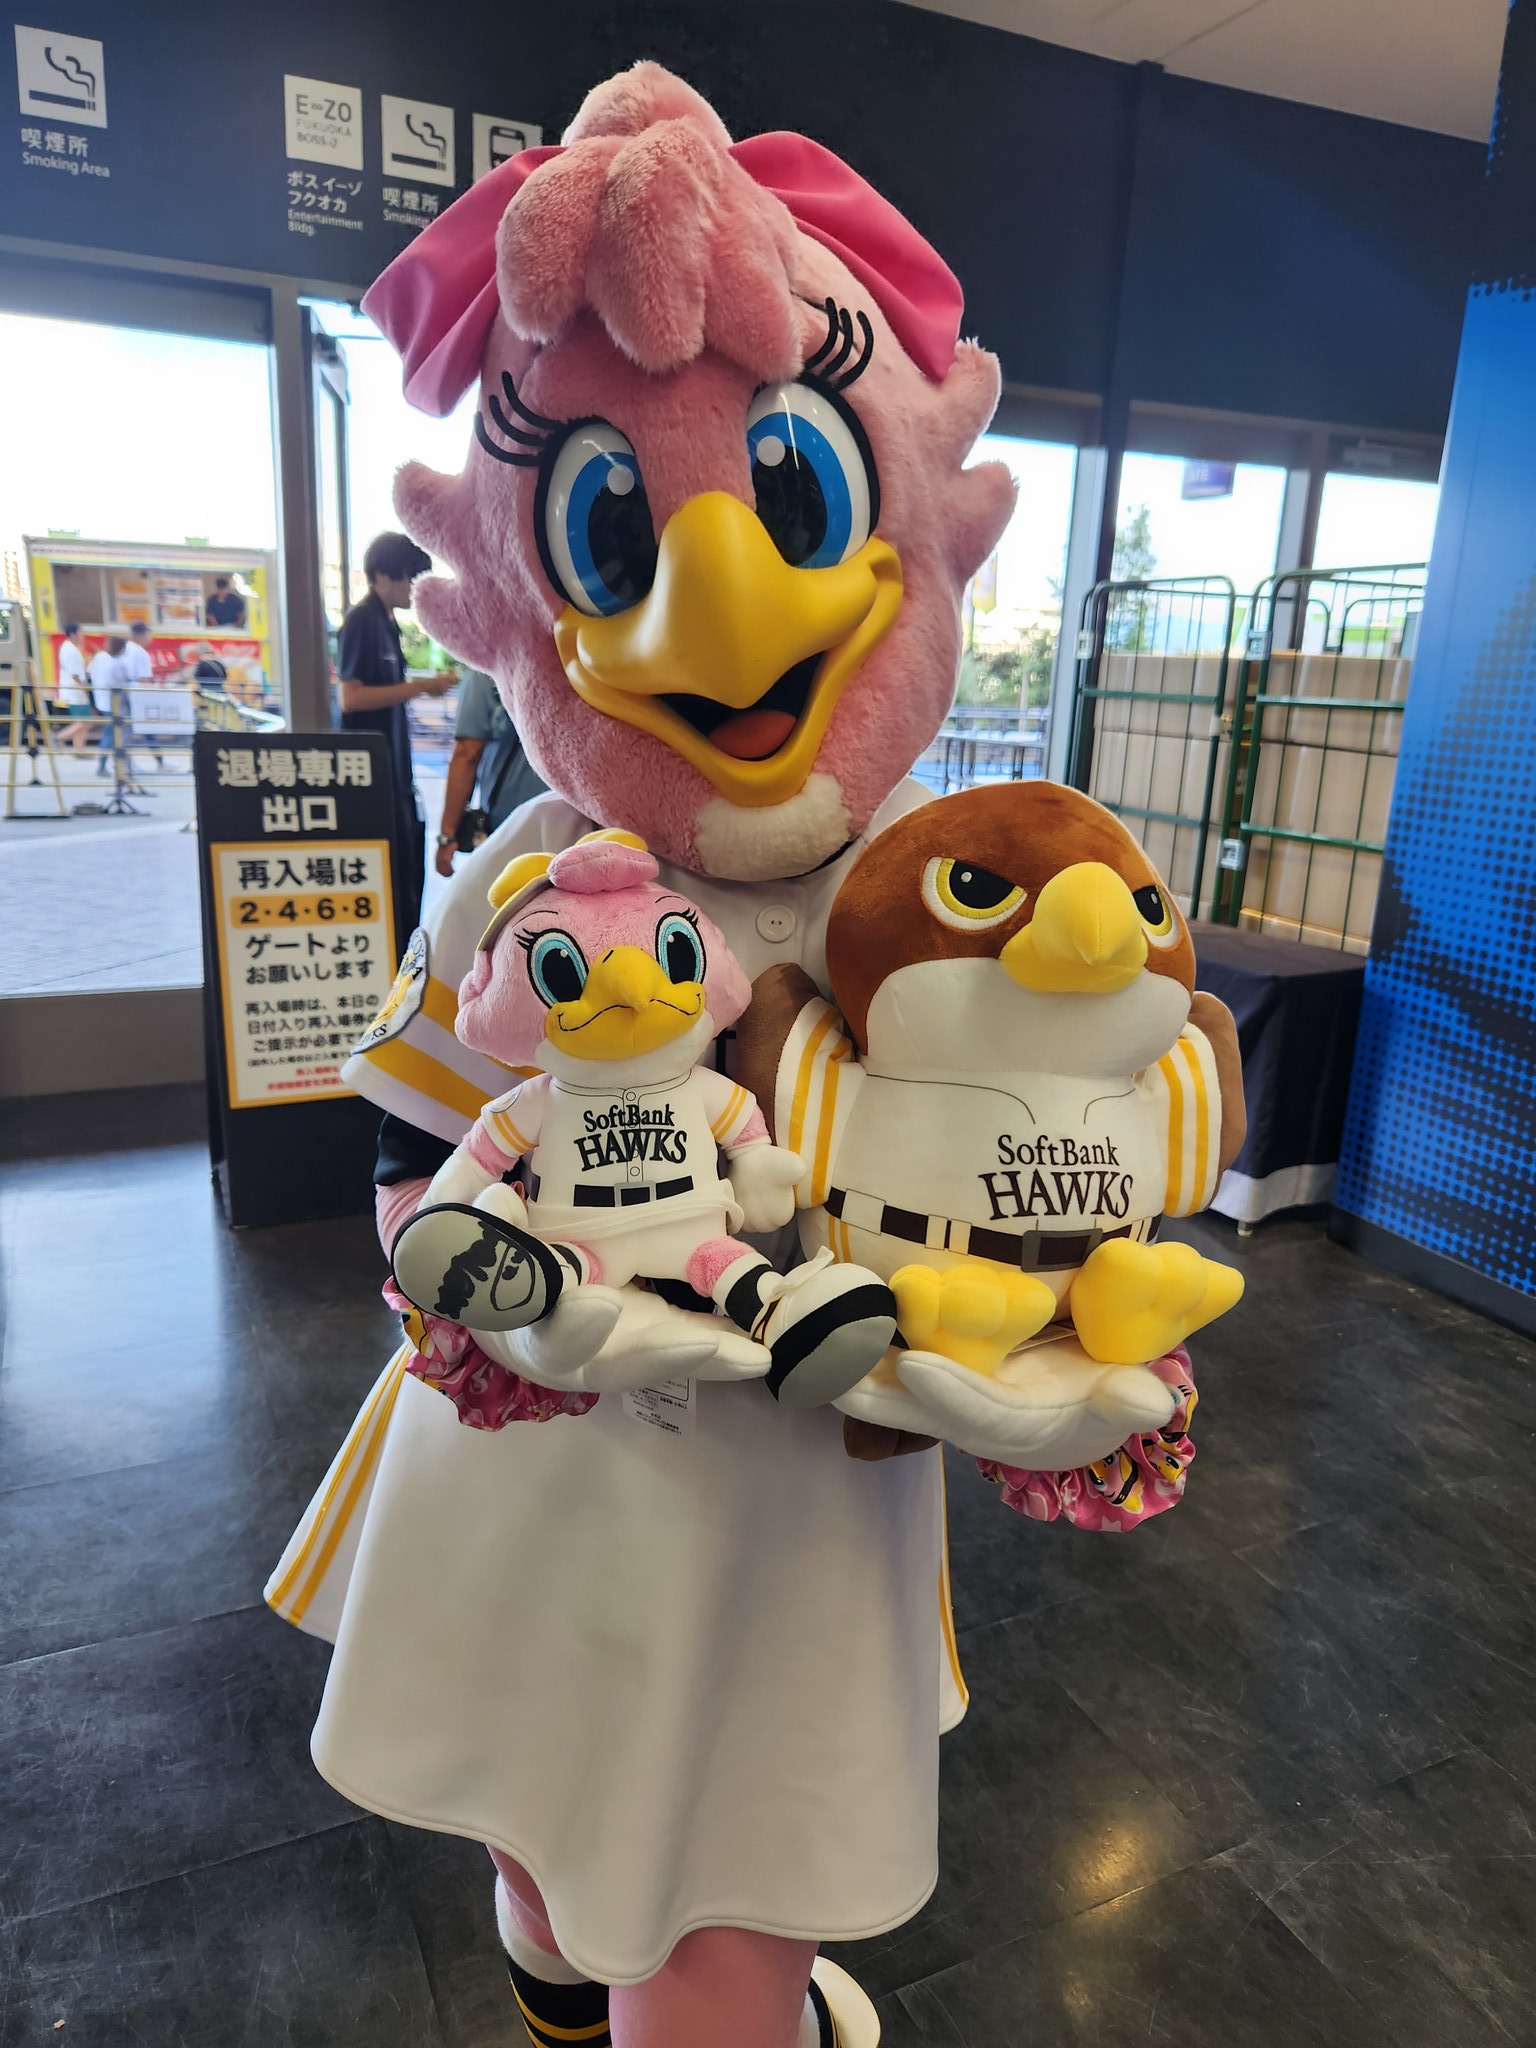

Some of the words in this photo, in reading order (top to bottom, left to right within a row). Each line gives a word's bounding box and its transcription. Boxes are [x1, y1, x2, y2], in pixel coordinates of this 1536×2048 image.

[21, 128, 88, 158] 喫煙所
[22, 151, 80, 176] Smoking
[81, 161, 111, 178] Area
[287, 190, 348, 214] フクオカ
[383, 187, 438, 214] 喫煙所
[287, 208, 364, 231] Entertainment
[216, 748, 373, 788] 退場専用
[262, 794, 338, 833] 出口
[237, 856, 368, 891] 再入場は
[245, 932, 370, 960] ゲートより
[246, 959, 375, 985] お願いします
[254, 1031, 364, 1052] ご提示が必要で
[583, 1103, 675, 1132] SoftBank
[573, 1128, 687, 1172] HAWKS
[997, 1134, 1120, 1166] SoftBank
[978, 1168, 1133, 1221] HAWKS
